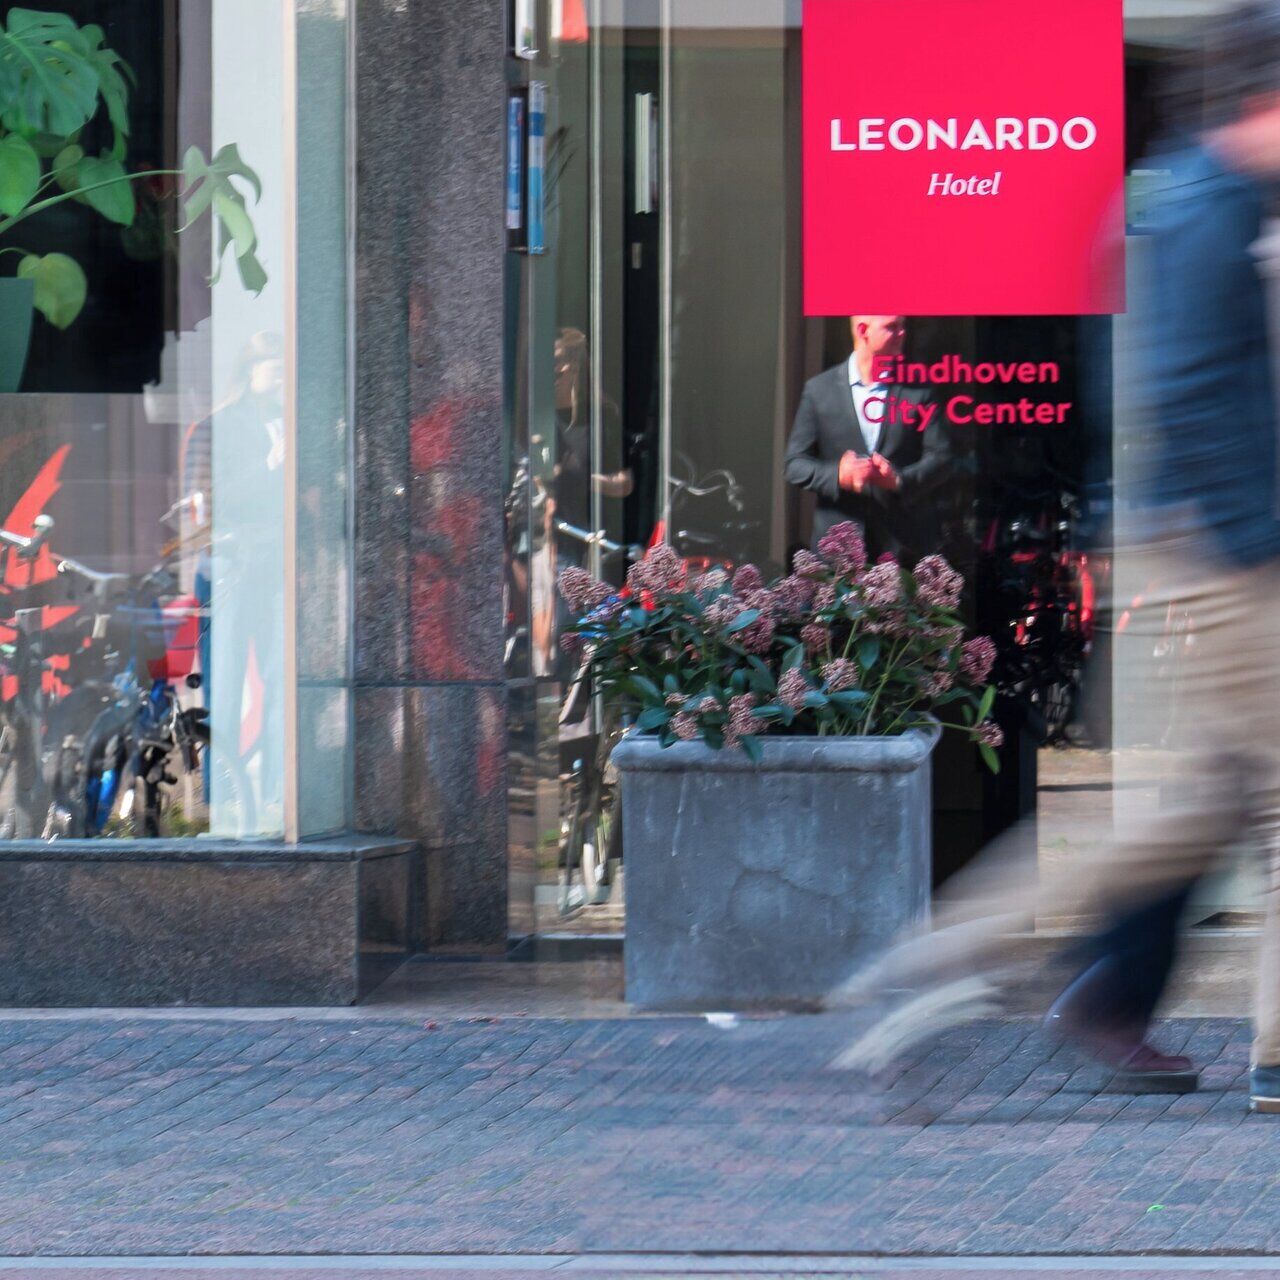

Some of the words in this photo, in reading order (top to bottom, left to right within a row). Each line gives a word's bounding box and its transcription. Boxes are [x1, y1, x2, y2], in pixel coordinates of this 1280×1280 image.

[830, 116, 1098, 151] LEONARDO
[926, 171, 1002, 196] Hotel
[871, 353, 1060, 384] Eindhoven
[862, 395, 939, 432] City
[945, 394, 1073, 425] Center
